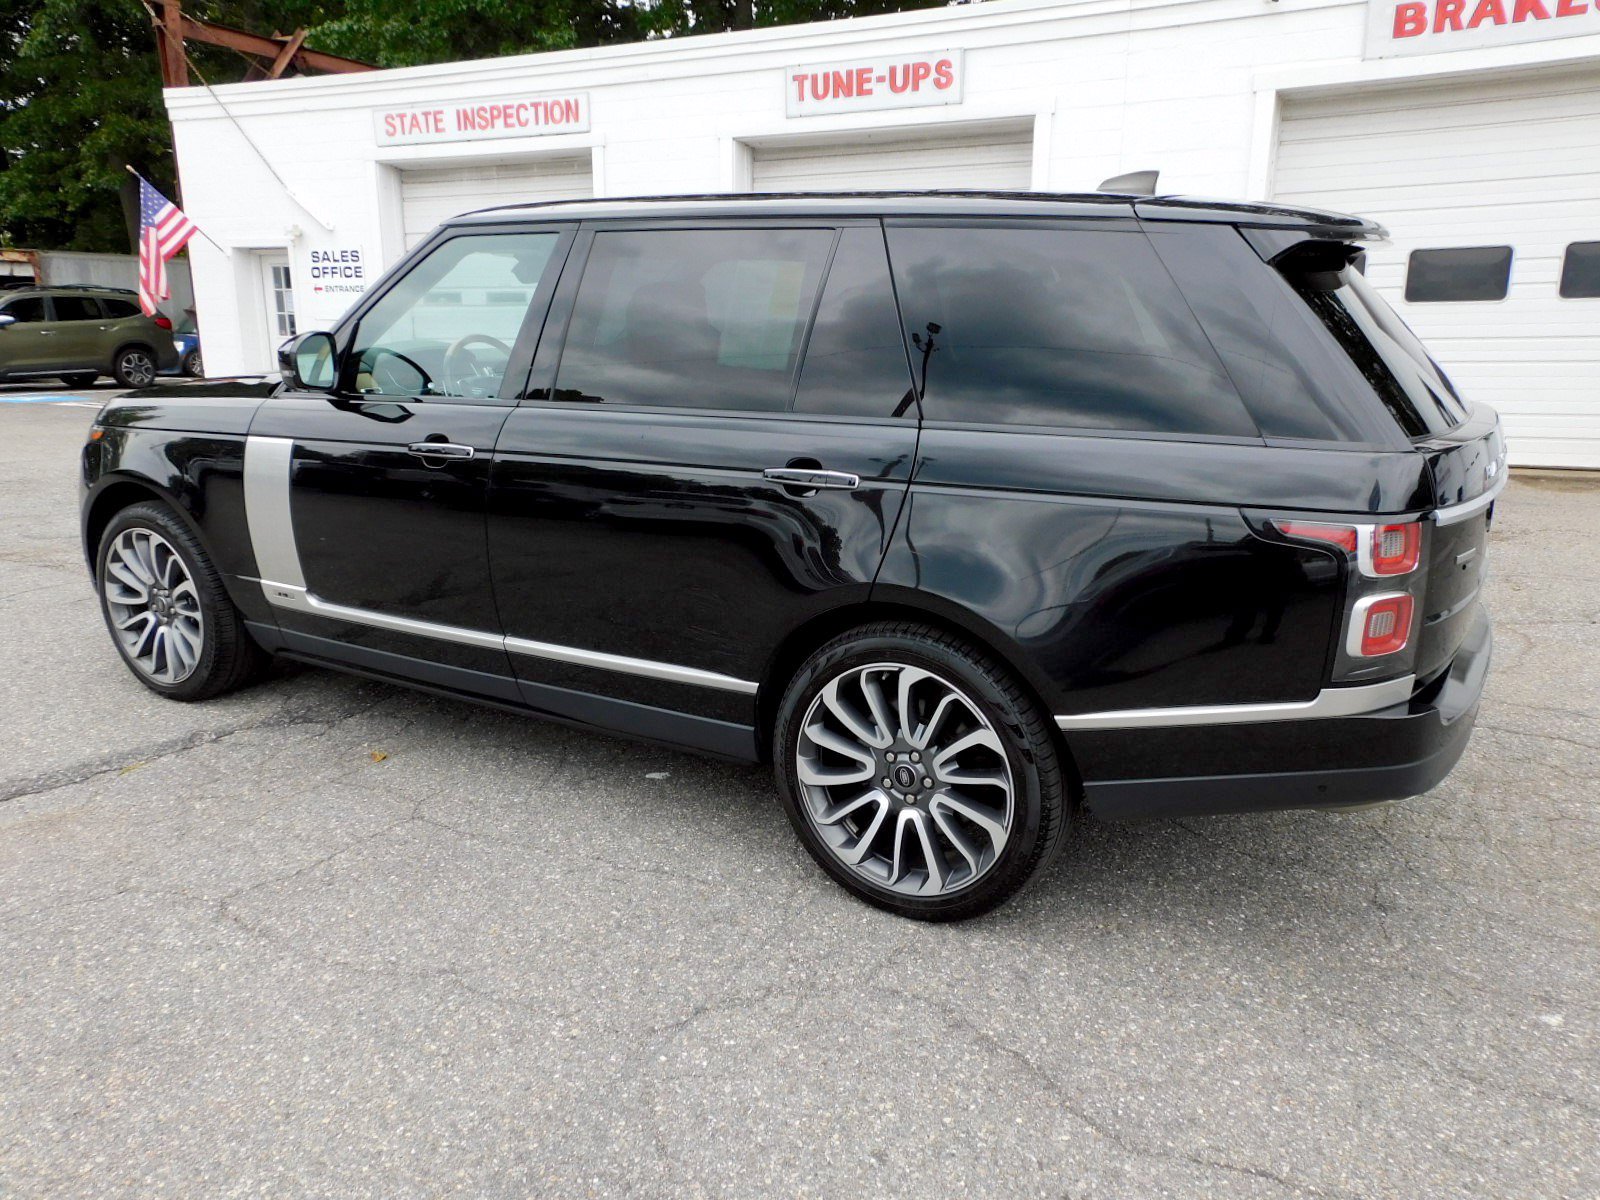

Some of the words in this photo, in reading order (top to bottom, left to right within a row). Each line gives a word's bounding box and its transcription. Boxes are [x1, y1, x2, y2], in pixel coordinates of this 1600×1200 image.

[792, 59, 954, 102] TUNE-UPS
[384, 110, 446, 137] STATE
[456, 98, 580, 131] INSPECTION
[311, 250, 360, 263] SALES
[311, 266, 363, 279] OFFICE
[324, 285, 365, 293] ENTRANCE
